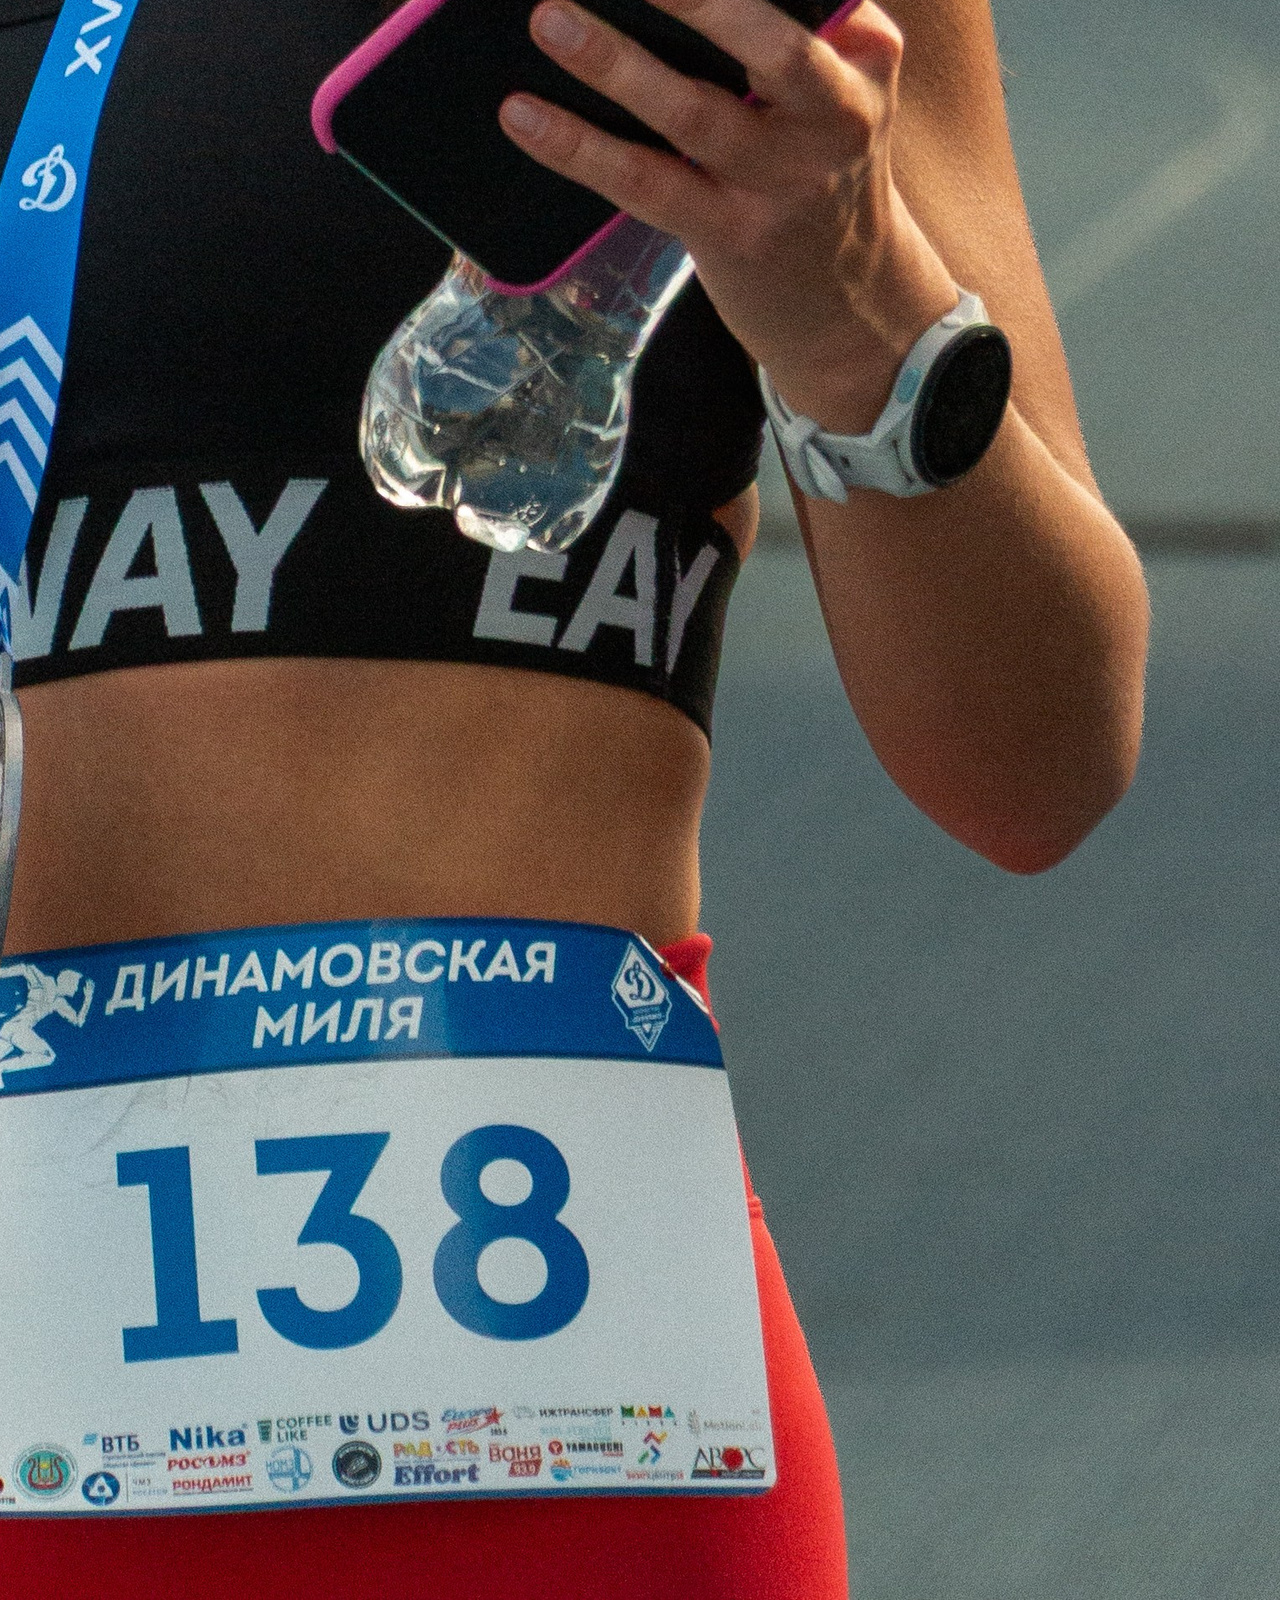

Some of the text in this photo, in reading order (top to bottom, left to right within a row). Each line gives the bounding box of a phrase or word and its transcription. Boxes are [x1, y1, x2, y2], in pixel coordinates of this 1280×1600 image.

[104, 940, 557, 1015] ДИНАМОВСКАЯ
[252, 996, 423, 1048] МИЛЯ
[115, 1124, 591, 1364] 138
[276, 1414, 332, 1430] COFFEE
[367, 1411, 430, 1433] UDS
[102, 1434, 140, 1453] ВТБ
[170, 1425, 246, 1451] Nika
[277, 1430, 308, 1443] LIKE
[172, 1475, 253, 1492] РОНДАМИТ
[394, 1463, 480, 1486] Effort
